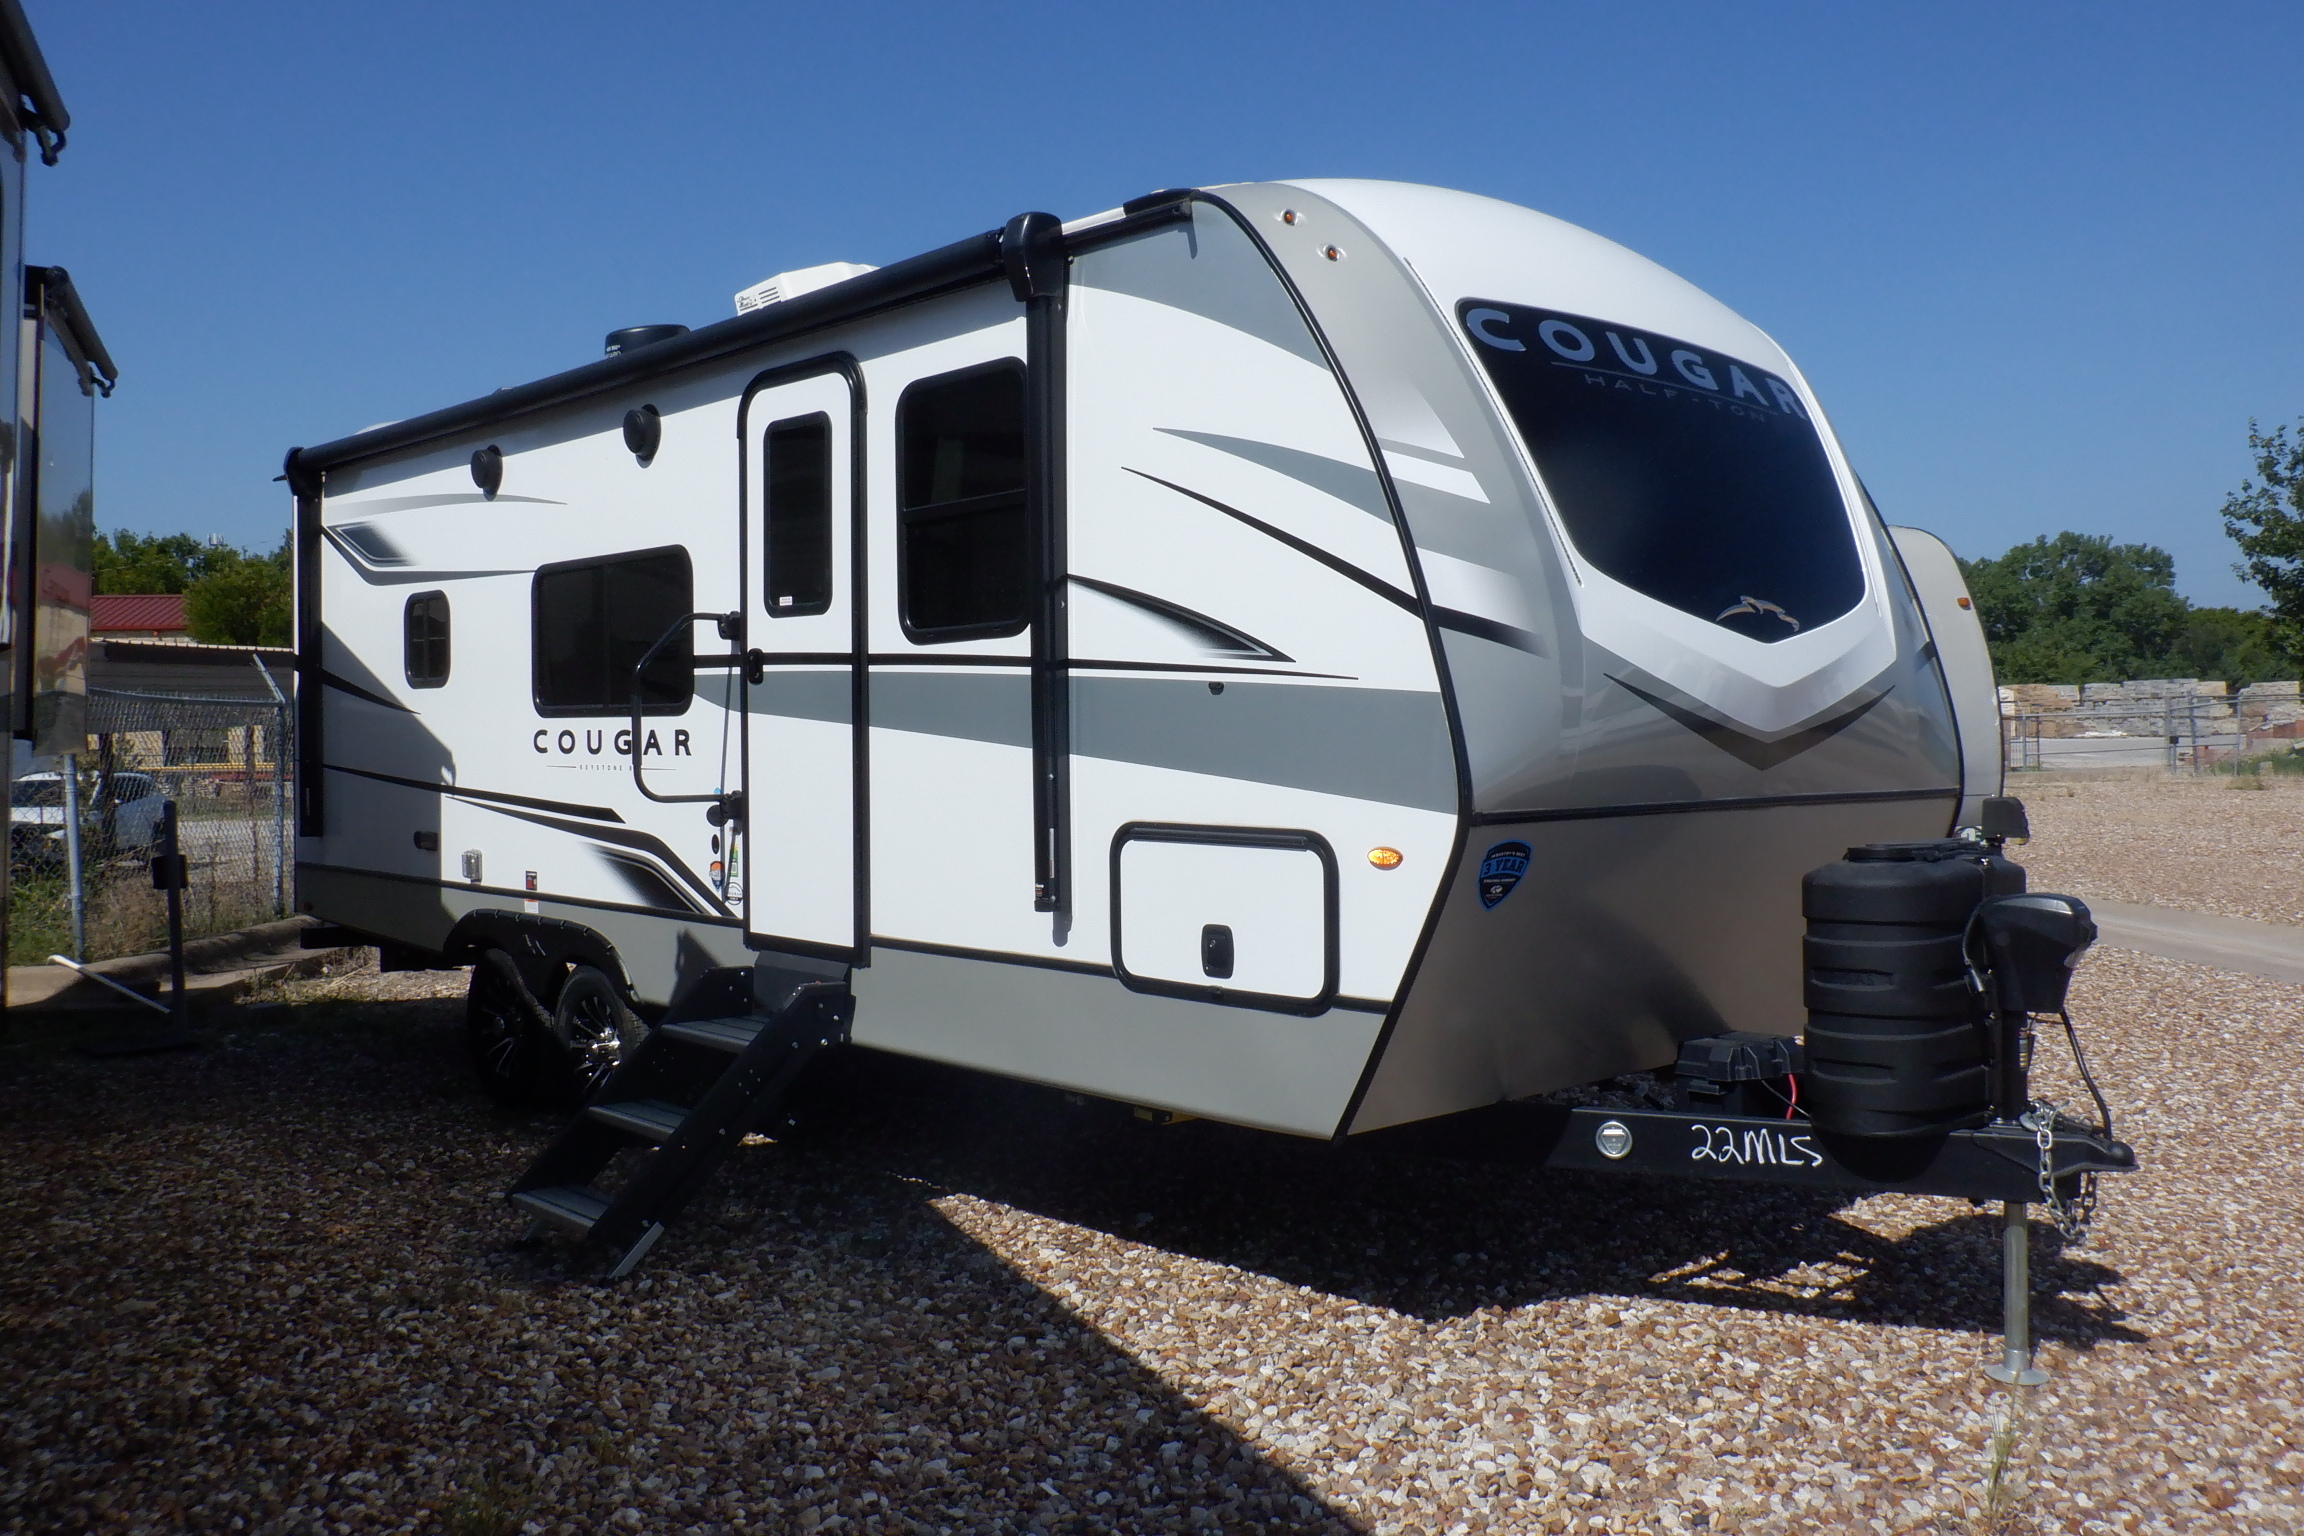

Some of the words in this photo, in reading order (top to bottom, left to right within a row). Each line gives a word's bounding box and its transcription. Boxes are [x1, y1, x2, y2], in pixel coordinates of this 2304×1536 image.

[1465, 307, 1809, 421] COUGAR
[533, 729, 692, 756] COUGAR
[579, 764, 623, 772] KEYSTONE
[1483, 861, 1492, 876] 3
[1495, 858, 1526, 874] YEAR
